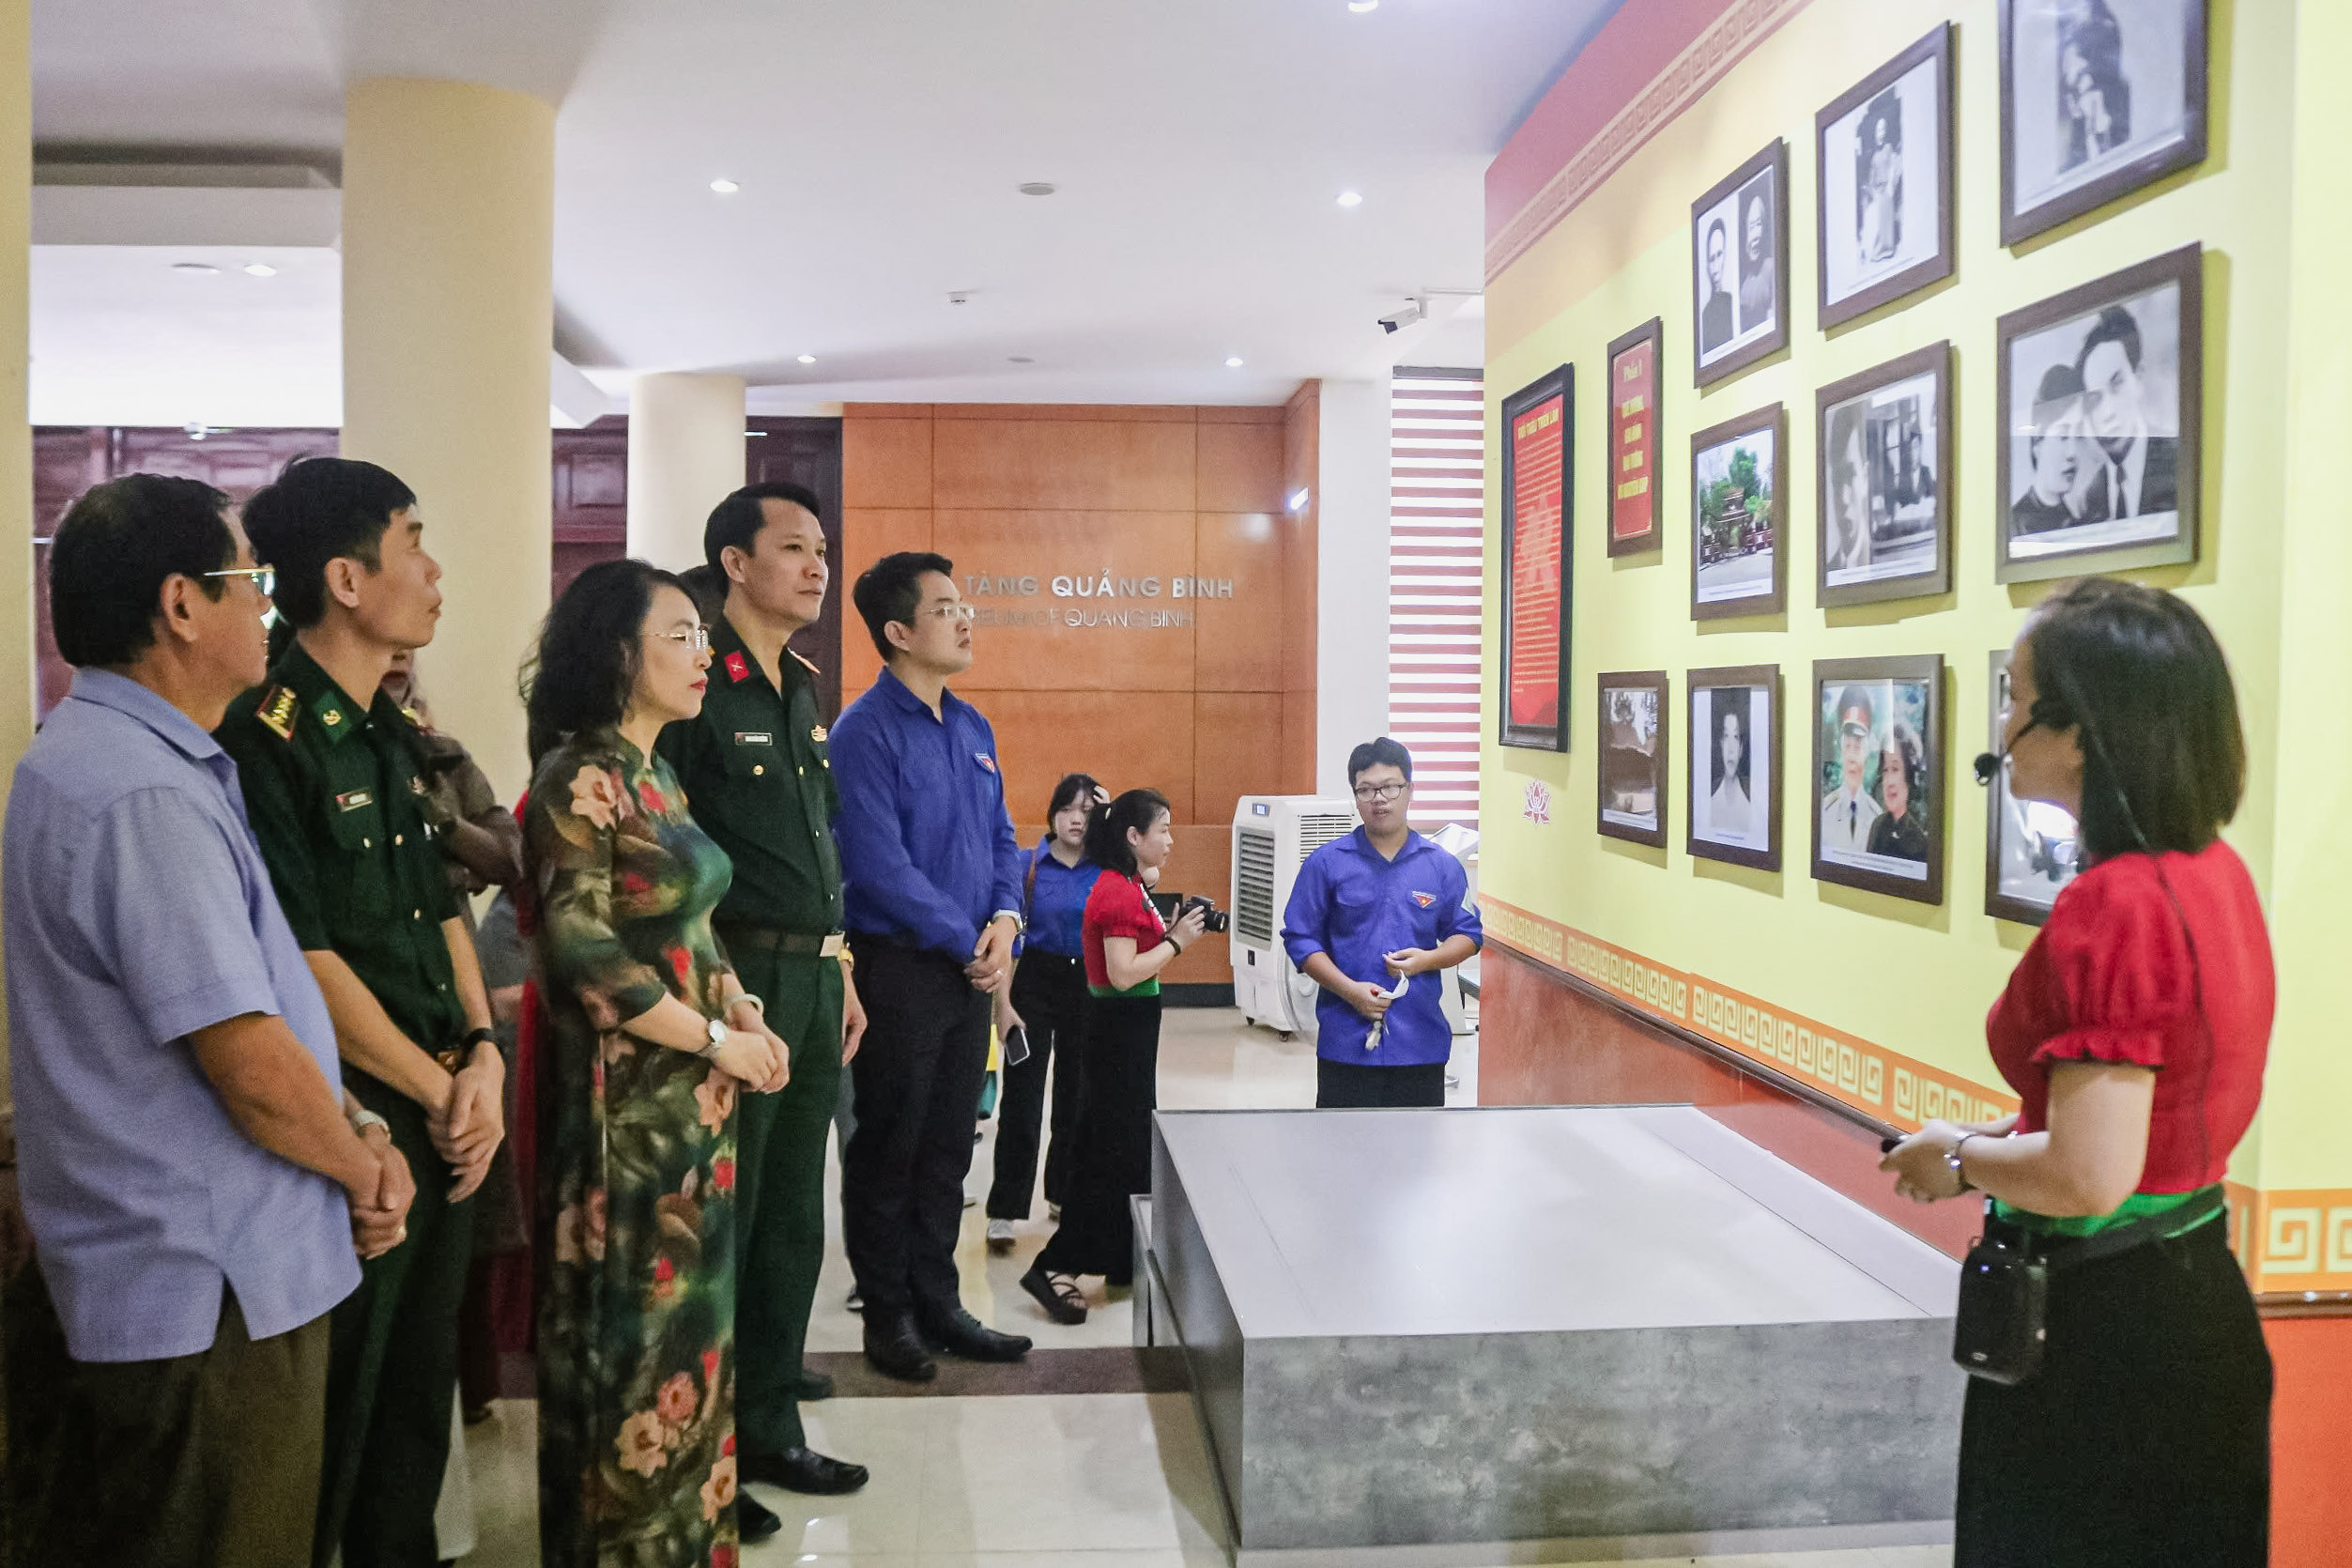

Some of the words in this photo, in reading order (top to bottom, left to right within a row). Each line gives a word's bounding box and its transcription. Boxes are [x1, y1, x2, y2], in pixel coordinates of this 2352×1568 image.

[964, 570, 1038, 596] TÀNG
[1052, 567, 1161, 597] QUẢNG
[1172, 573, 1233, 598] BÌNH
[1064, 608, 1145, 628] QUANG
